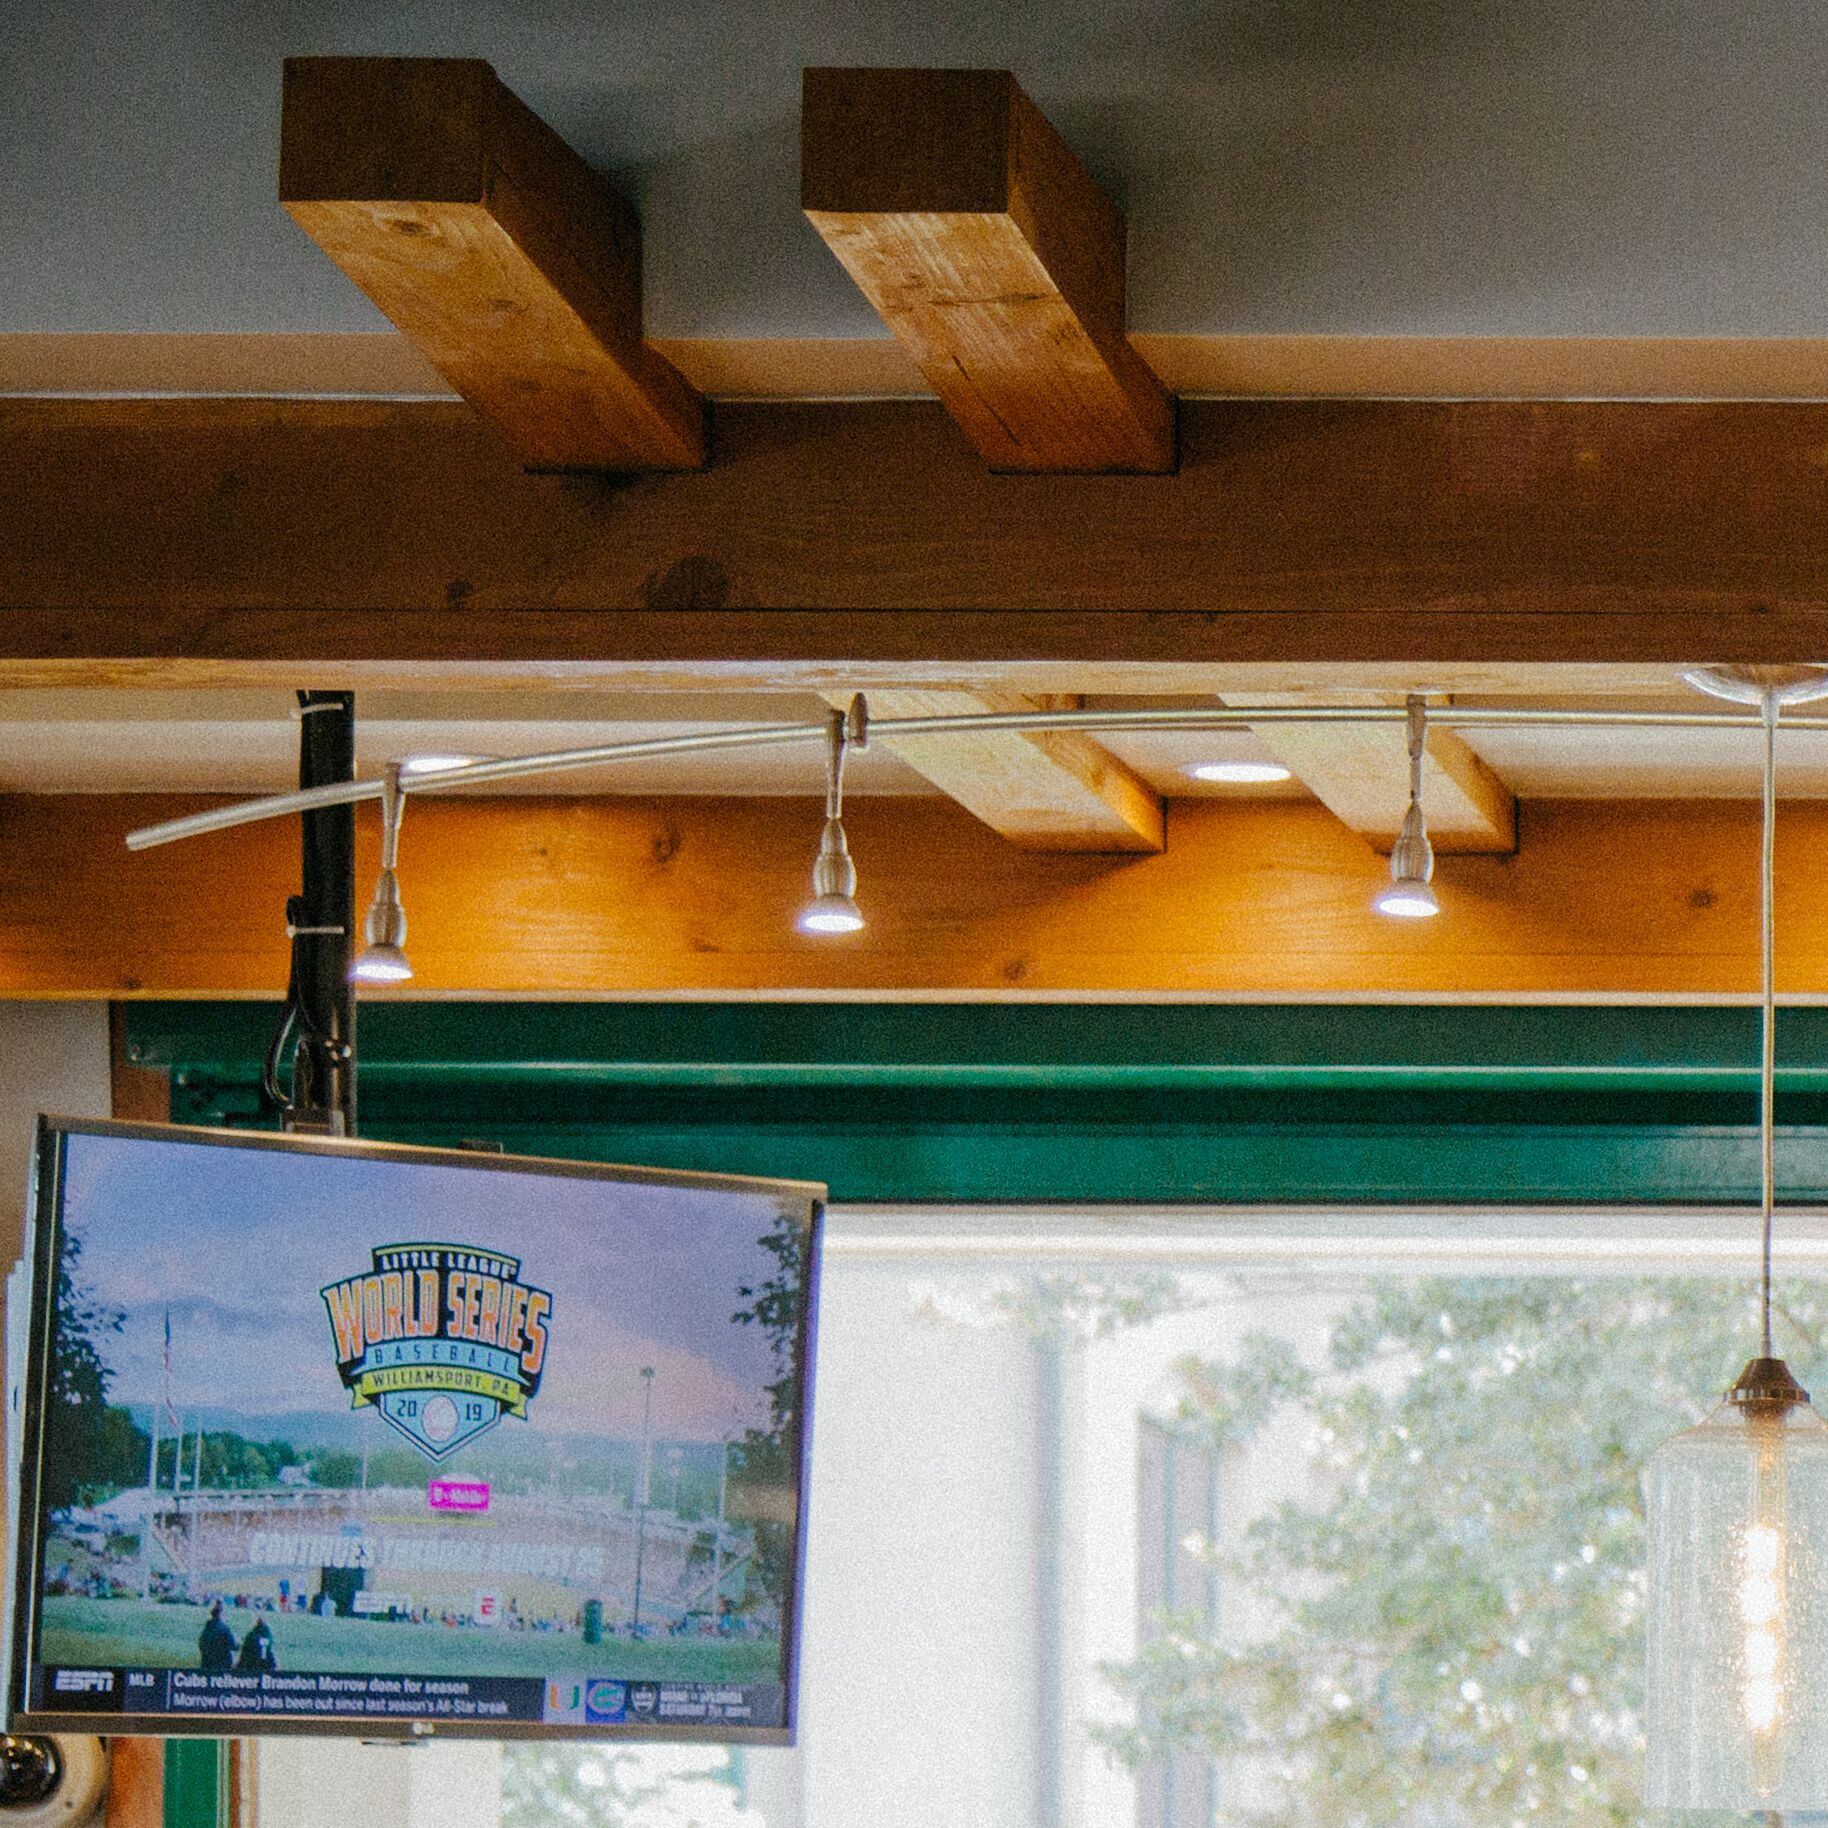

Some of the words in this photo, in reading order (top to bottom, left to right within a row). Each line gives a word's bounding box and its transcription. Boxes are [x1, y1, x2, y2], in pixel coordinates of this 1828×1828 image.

[381, 1251, 441, 1271] LITTLE
[324, 1269, 440, 1364] WORLD
[446, 1269, 552, 1375] SERIES
[373, 1344, 511, 1373] BASEBALL
[397, 1399, 418, 1418] 20
[464, 1402, 483, 1421] 19
[55, 1670, 114, 1691] ESPN
[129, 1673, 154, 1687] MLB
[173, 1672, 208, 1688] Cubs
[210, 1673, 259, 1690] reliever
[261, 1675, 316, 1691] Brandon
[318, 1677, 369, 1692] Morrow
[369, 1678, 401, 1693] done
[403, 1679, 422, 1693] for
[424, 1681, 469, 1695] season
[173, 1693, 218, 1708] Morrow
[219, 1694, 262, 1711] (elbow)
[263, 1695, 284, 1709] has
[285, 1696, 314, 1710] been
[314, 1697, 333, 1711] out
[334, 1698, 364, 1712] since
[365, 1699, 386, 1713] last
[387, 1699, 435, 1714] season's
[476, 1701, 509, 1715] break
